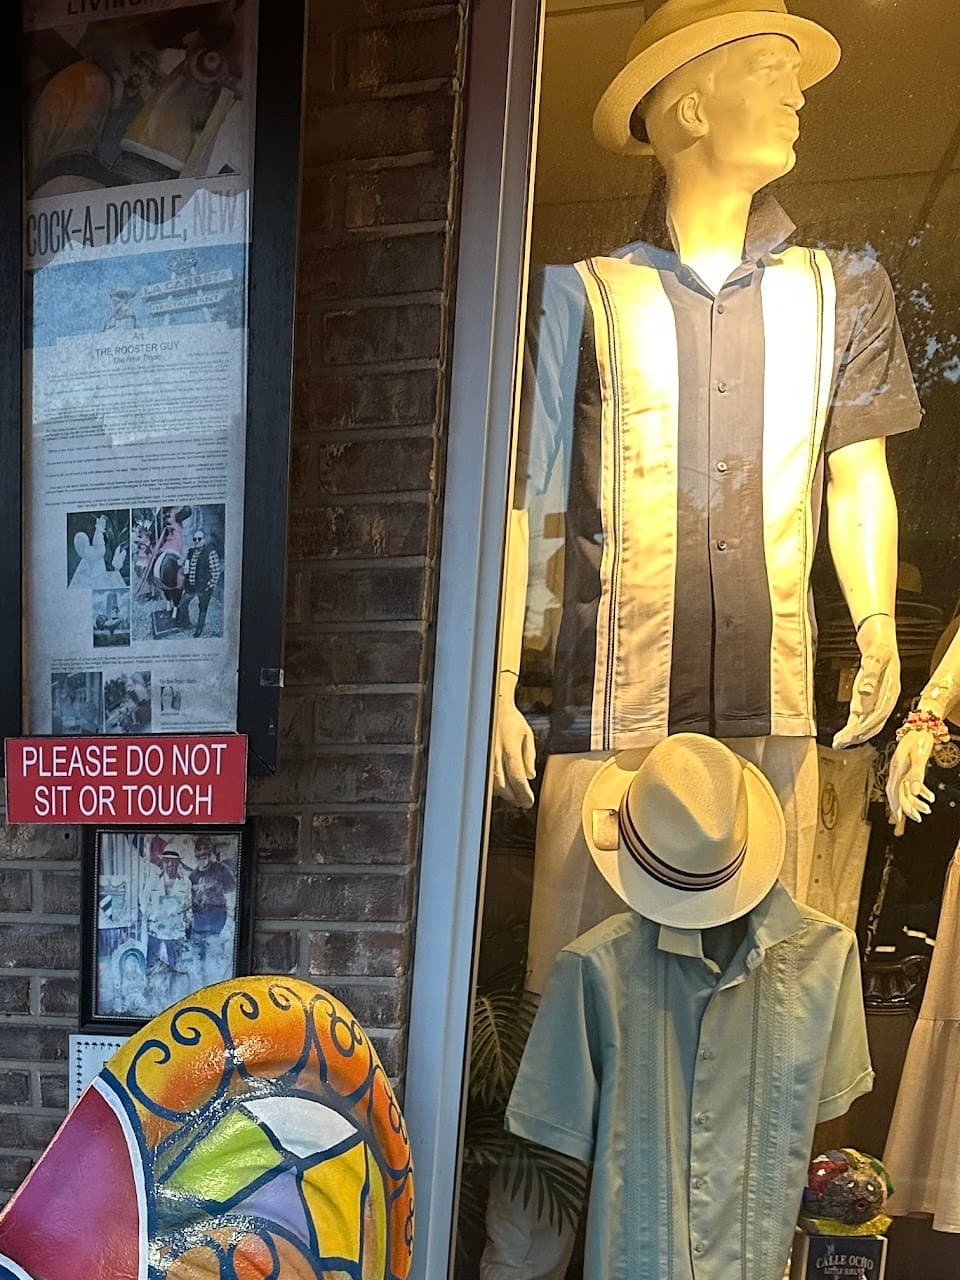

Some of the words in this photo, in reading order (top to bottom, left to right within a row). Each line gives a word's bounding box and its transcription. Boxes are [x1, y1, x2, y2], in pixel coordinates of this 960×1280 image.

[26, 194, 188, 257] COCK-A-DOODLE,
[95, 347, 112, 357] THE
[114, 343, 158, 354] ROOSTER
[160, 341, 179, 351] GUY
[22, 745, 117, 777] PLEASE
[126, 744, 164, 777] DO
[172, 743, 227, 776] NOT
[34, 785, 72, 817] SIT
[78, 785, 116, 817] OR
[122, 784, 212, 816] TOUCH
[816, 1254, 847, 1269] CALLE
[848, 1255, 874, 1270] OCHO
